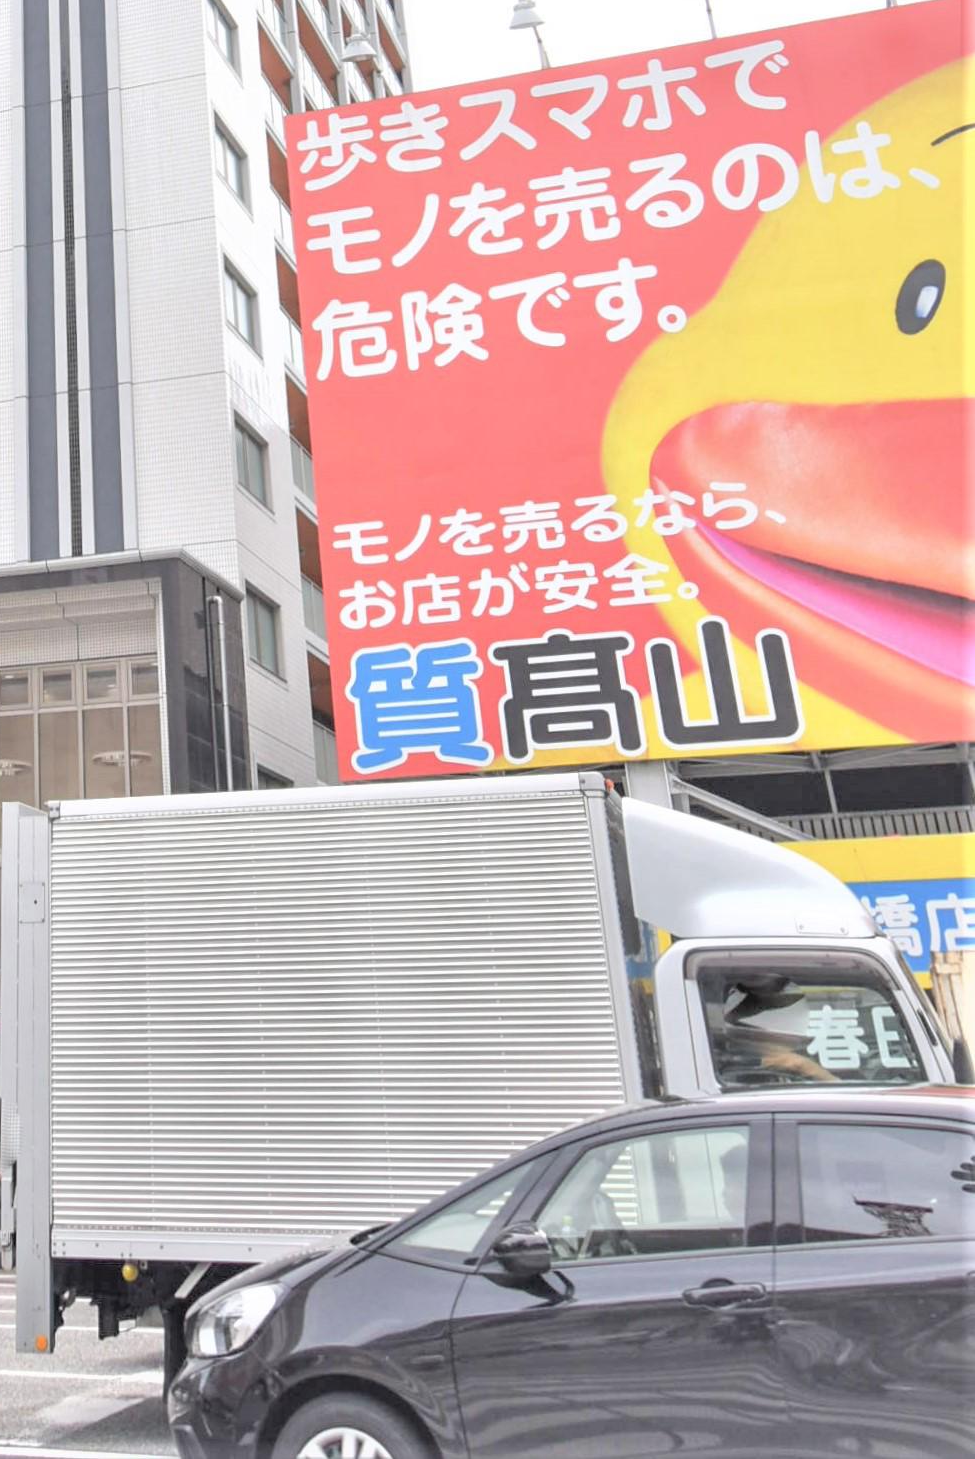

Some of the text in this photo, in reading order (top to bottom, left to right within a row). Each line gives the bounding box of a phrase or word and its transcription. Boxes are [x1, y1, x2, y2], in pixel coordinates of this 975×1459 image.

[298, 40, 790, 192] 歩きスマホで
[306, 121, 940, 275] モノを売るのは、
[312, 257, 687, 381] 危険です。
[333, 481, 786, 565] モノを売るなら、
[339, 553, 699, 629] お店が安全。
